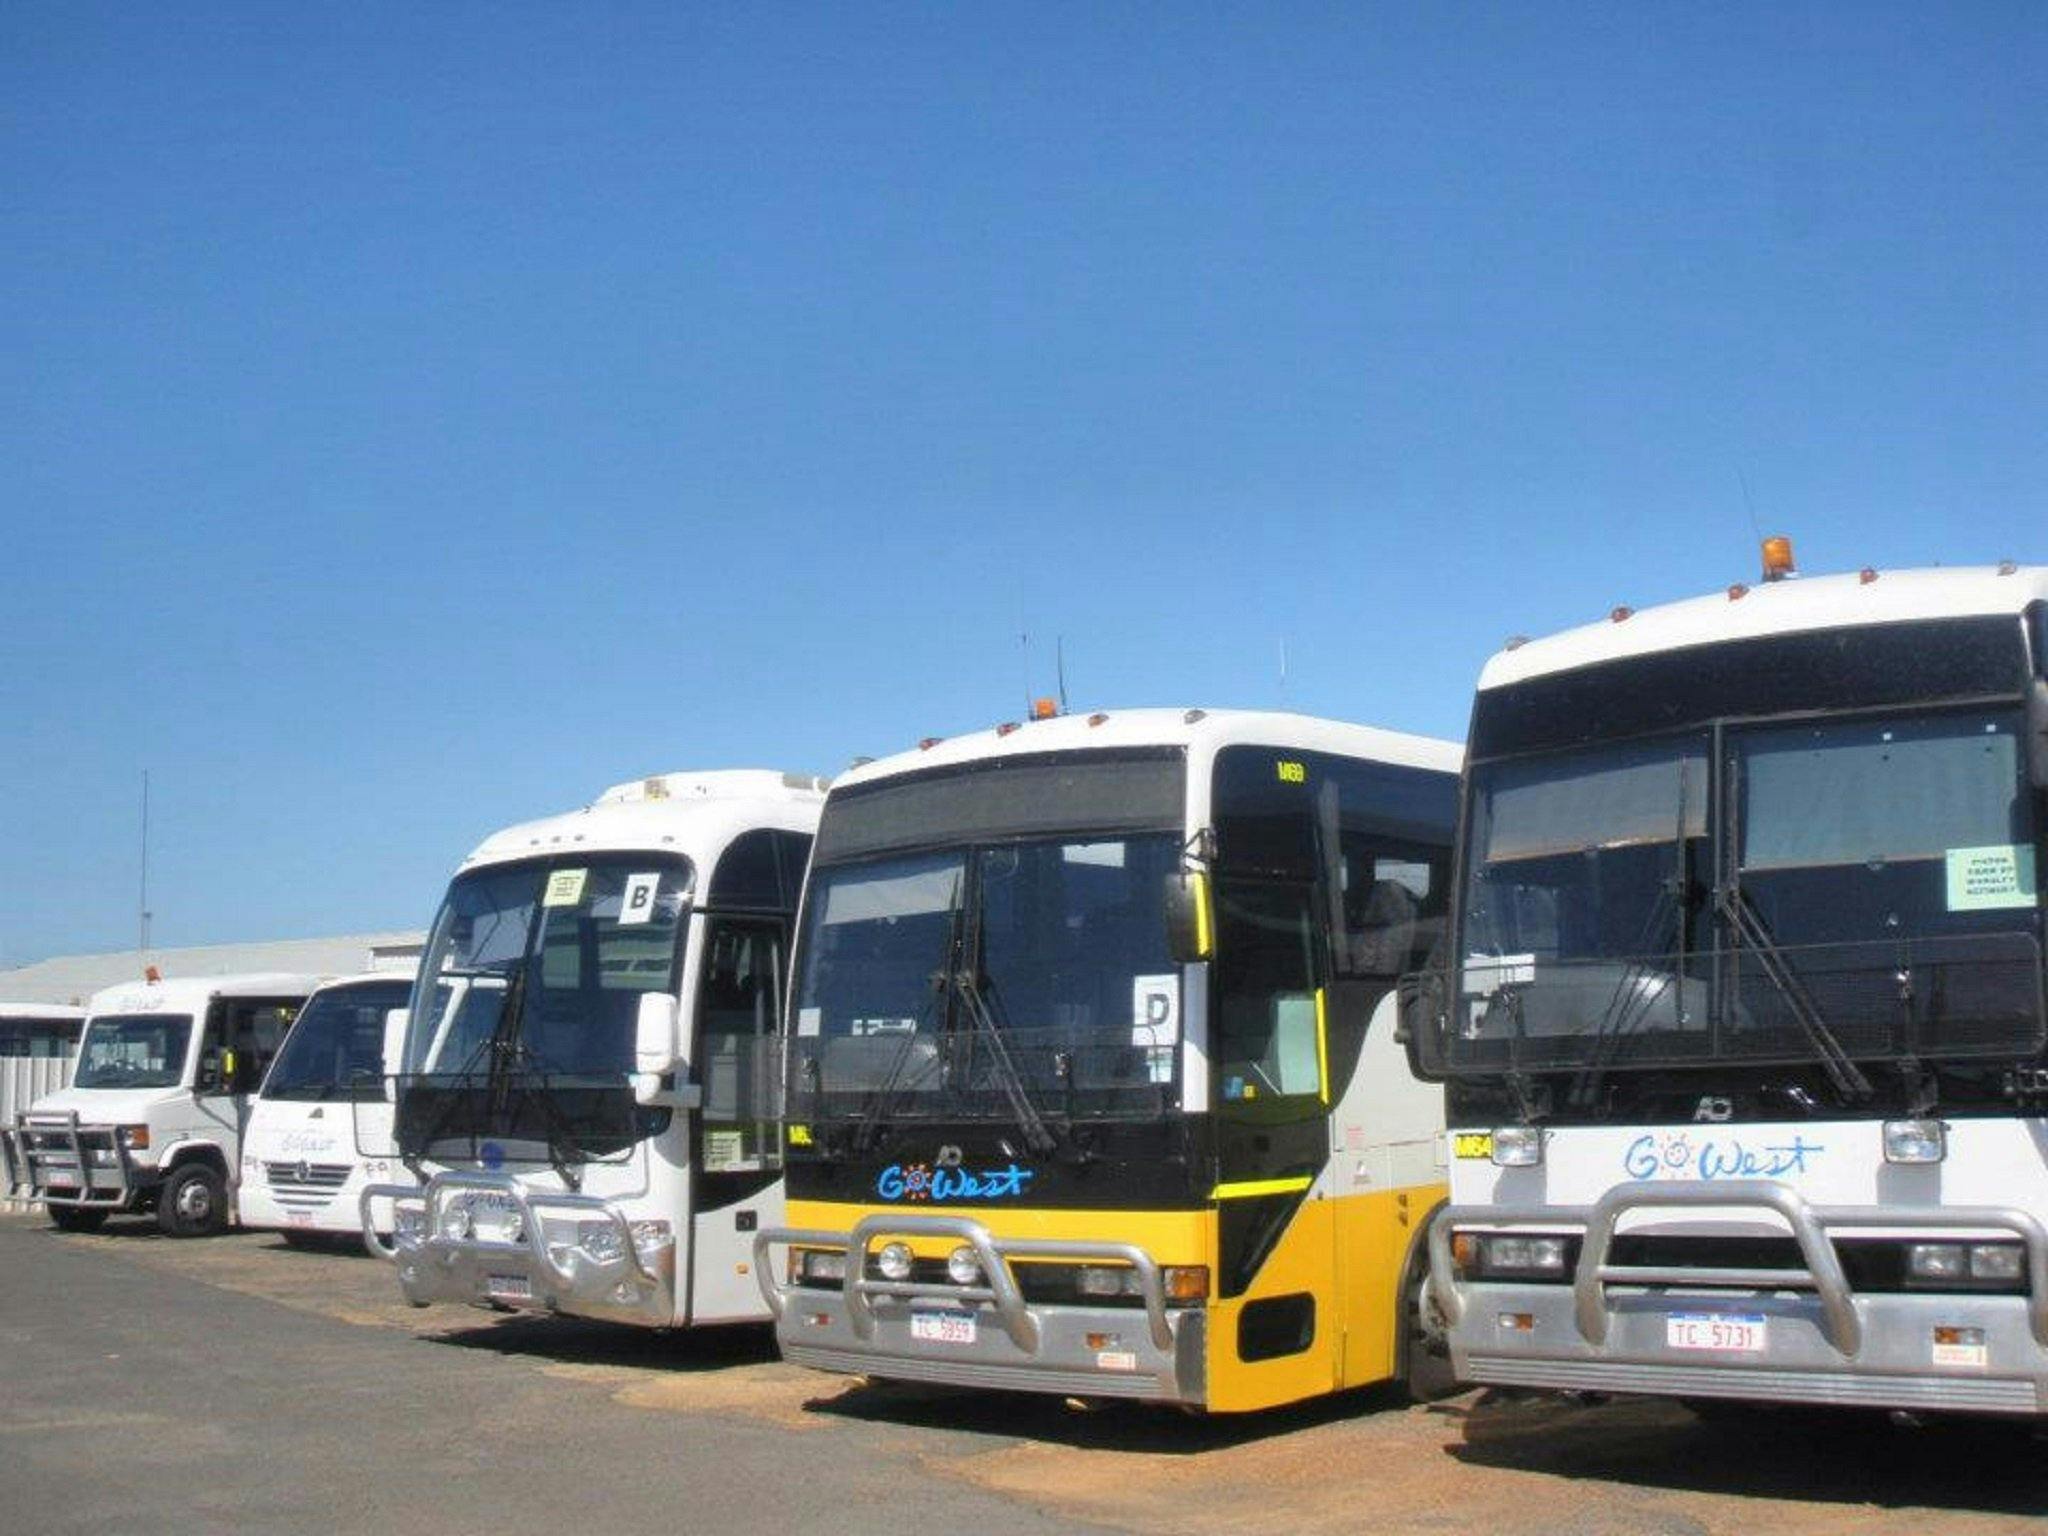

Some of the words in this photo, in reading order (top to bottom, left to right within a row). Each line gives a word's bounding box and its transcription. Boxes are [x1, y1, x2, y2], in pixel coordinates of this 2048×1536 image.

[630, 885, 650, 909] B
[1147, 993, 1170, 1025] D
[1699, 1136, 1824, 1179] West
[931, 1164, 1033, 1199] West
[1675, 1324, 1698, 1345] TC
[1712, 1323, 1753, 1347] 5731
